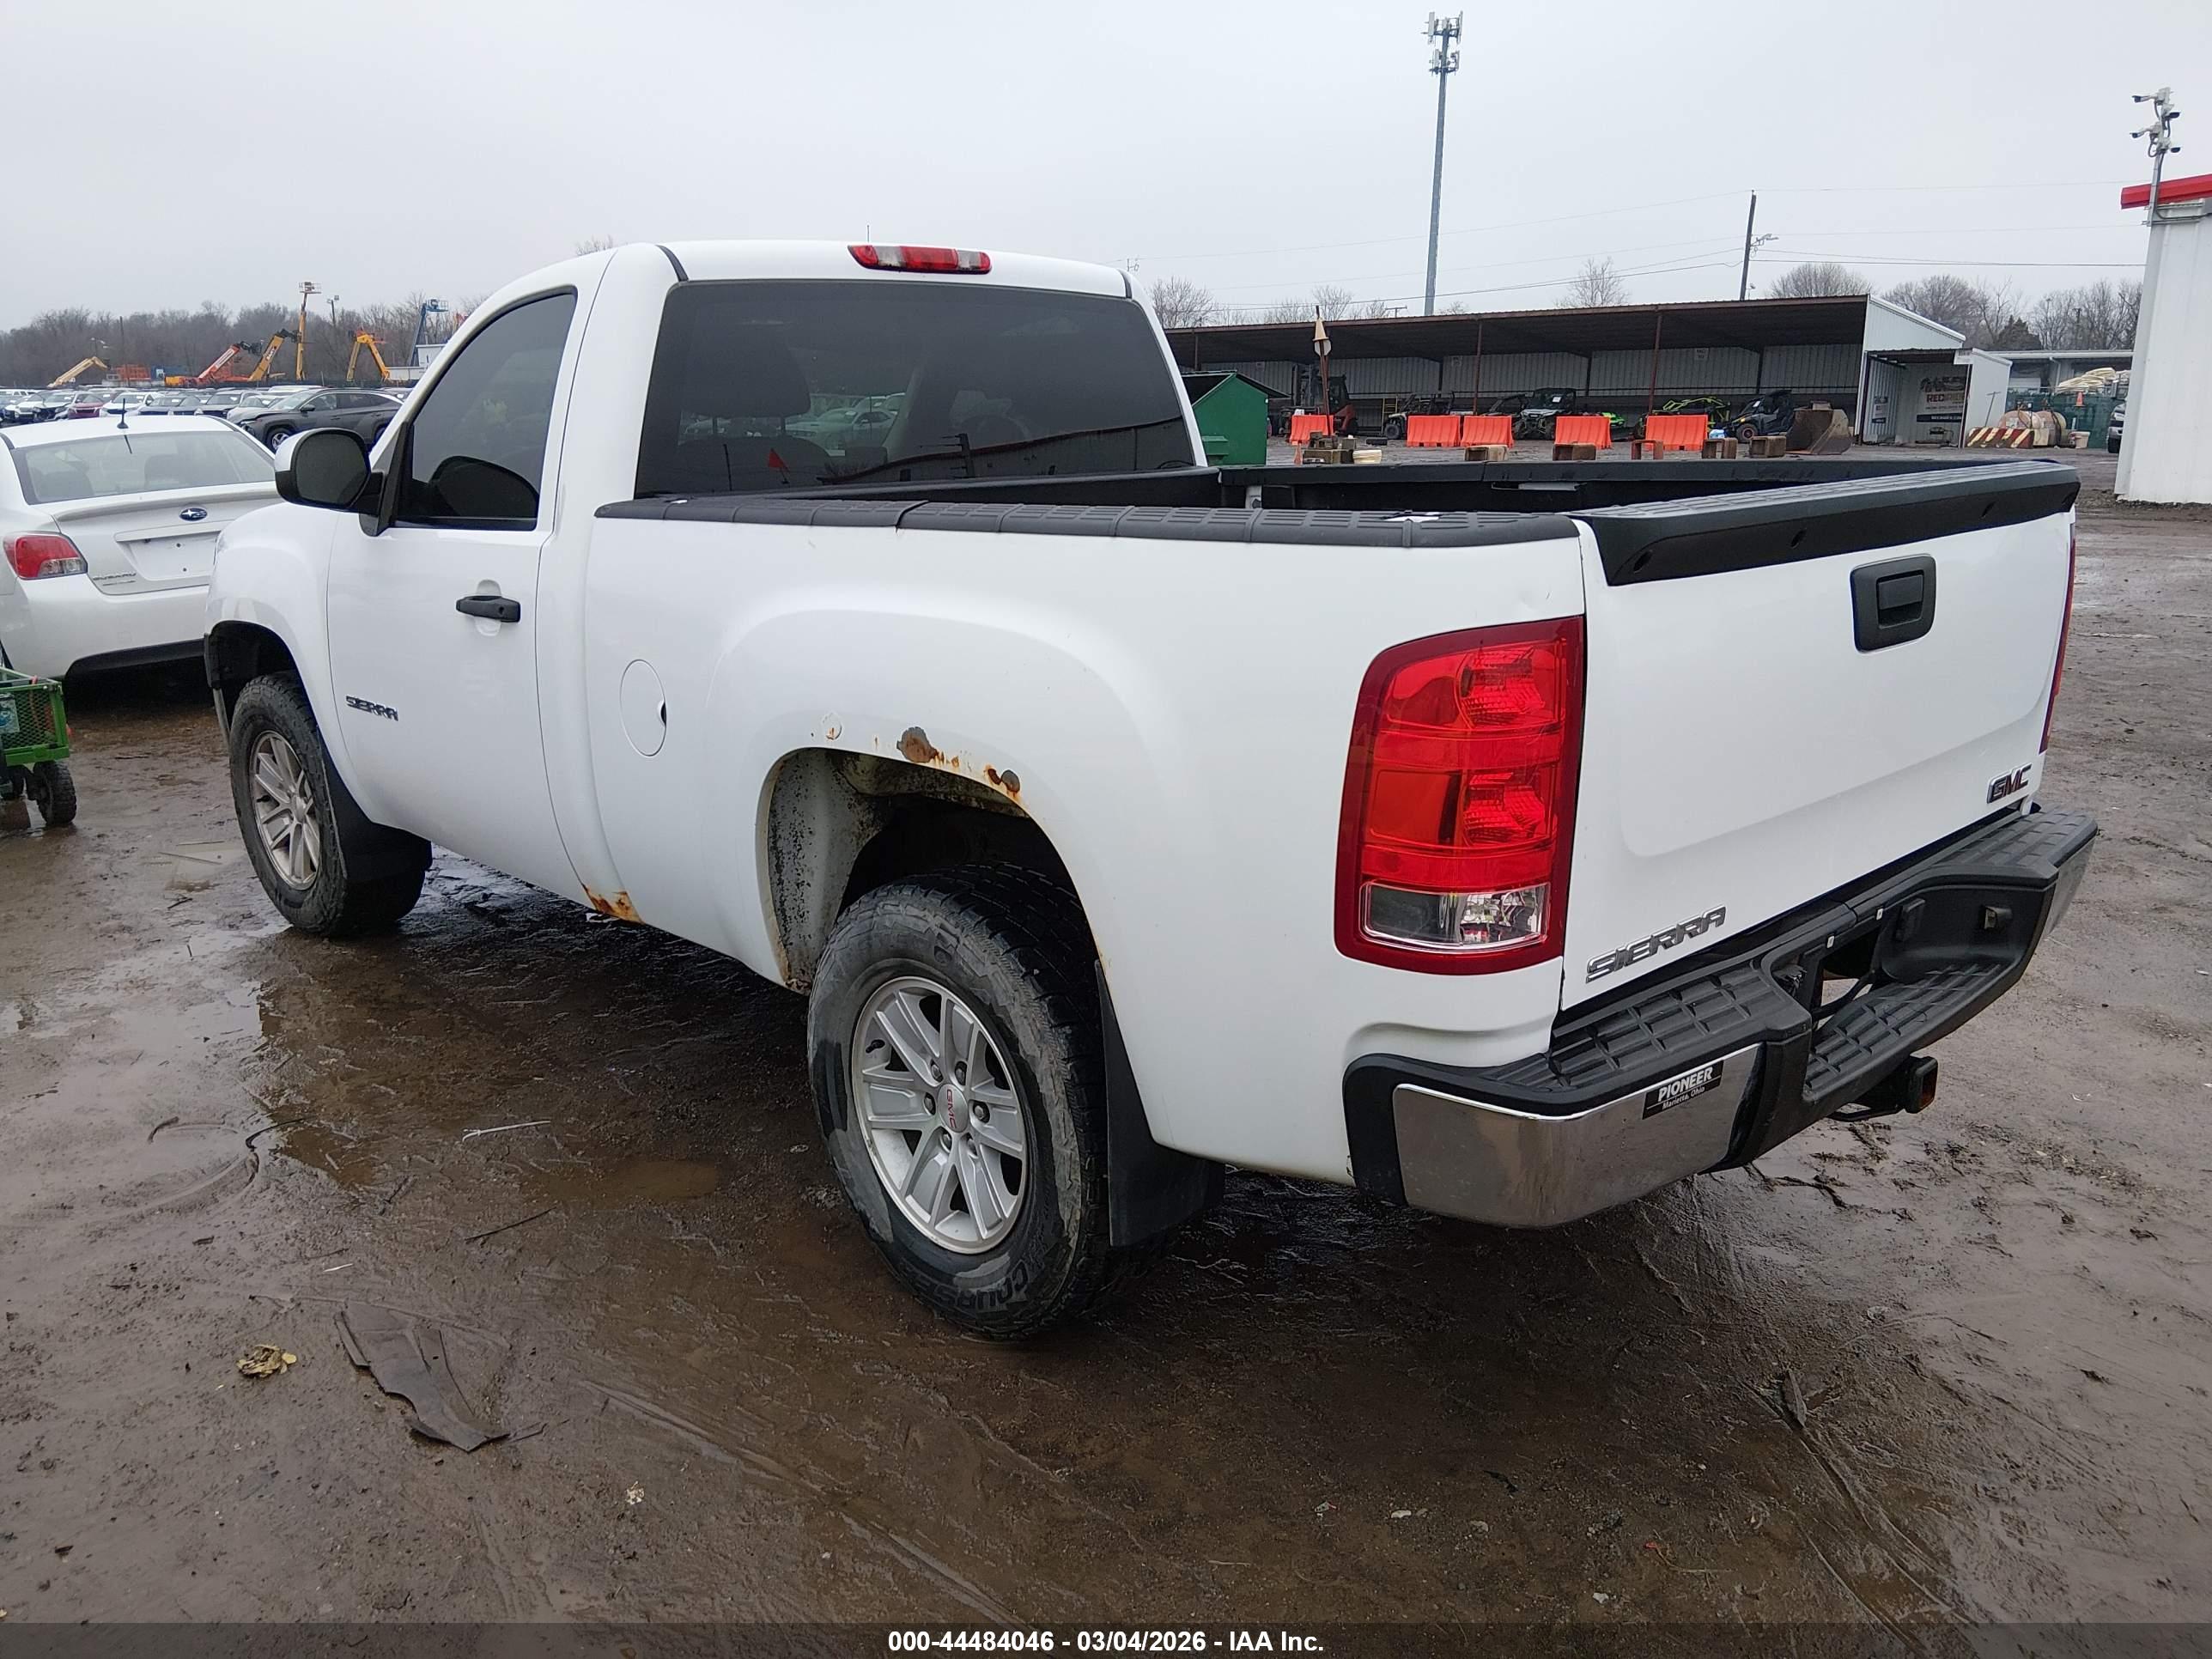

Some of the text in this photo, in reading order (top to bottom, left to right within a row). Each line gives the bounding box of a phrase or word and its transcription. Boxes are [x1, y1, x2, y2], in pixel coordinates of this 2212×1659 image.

[346, 695, 398, 721] SIERRA
[1987, 763, 2033, 804] GMC
[1586, 905, 1726, 984] SIERRA
[1657, 1066, 1713, 1102] PIONEER
[1690, 1086, 1705, 1098] Ohio
[947, 1089, 957, 1128] GMC
